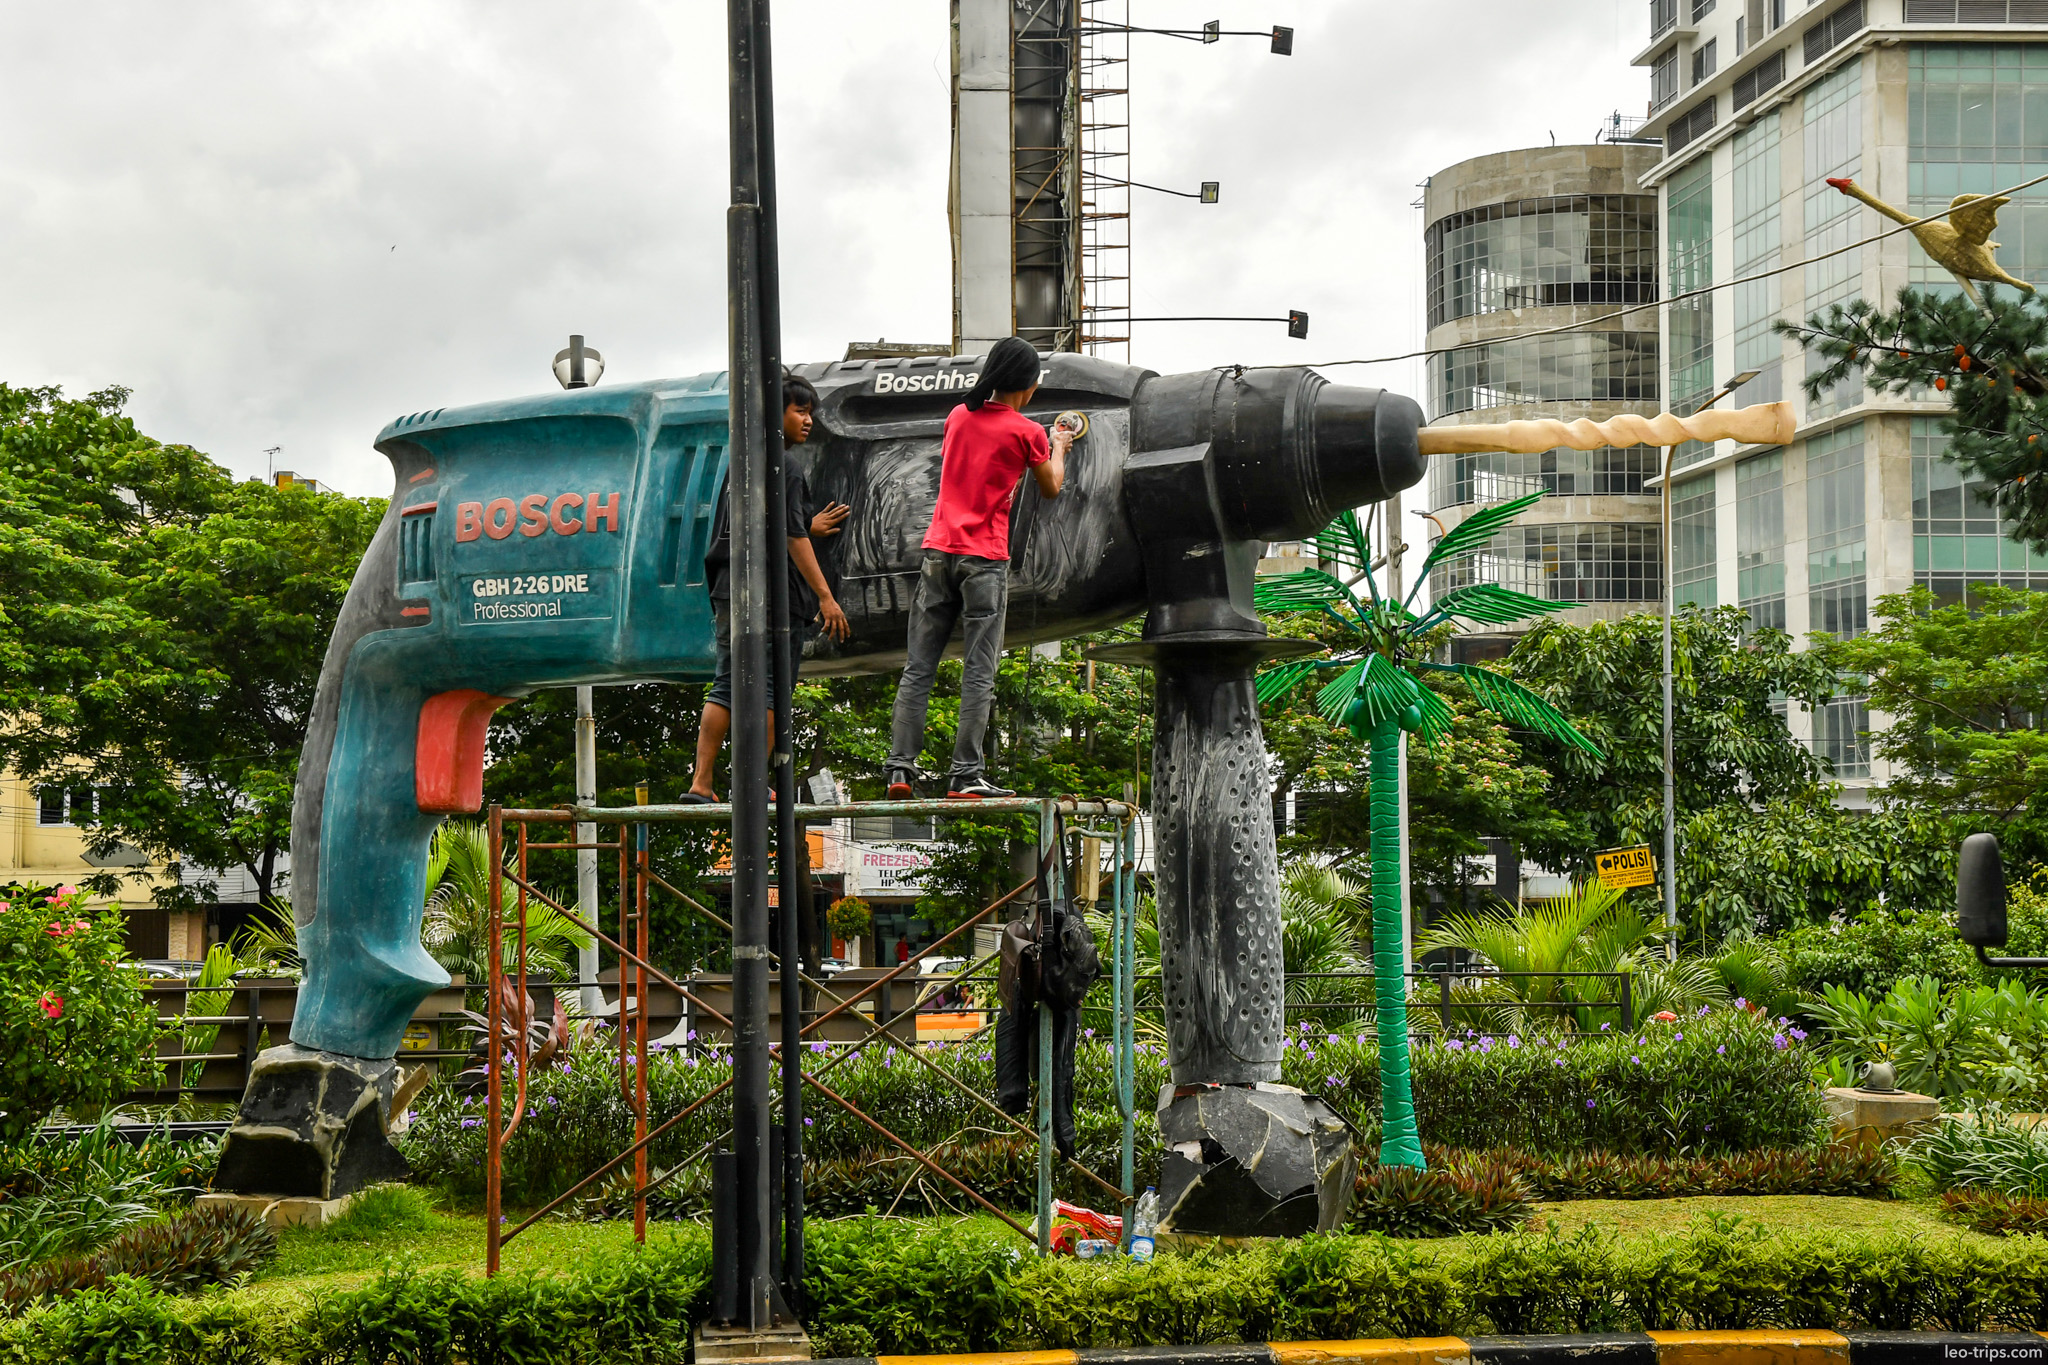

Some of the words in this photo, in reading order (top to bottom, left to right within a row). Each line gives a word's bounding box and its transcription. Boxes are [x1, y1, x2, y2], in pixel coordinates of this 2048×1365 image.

[874, 369, 1051, 393] Boschhar
[456, 492, 620, 543] BOSCH
[472, 578, 510, 597] GBH
[512, 576, 550, 595] 2-26
[551, 574, 589, 593] DRE
[474, 598, 561, 620] Professional
[863, 854, 918, 867] FREEZER
[921, 854, 930, 867] &
[1612, 851, 1648, 870] POLISI
[881, 879, 895, 887] HP
